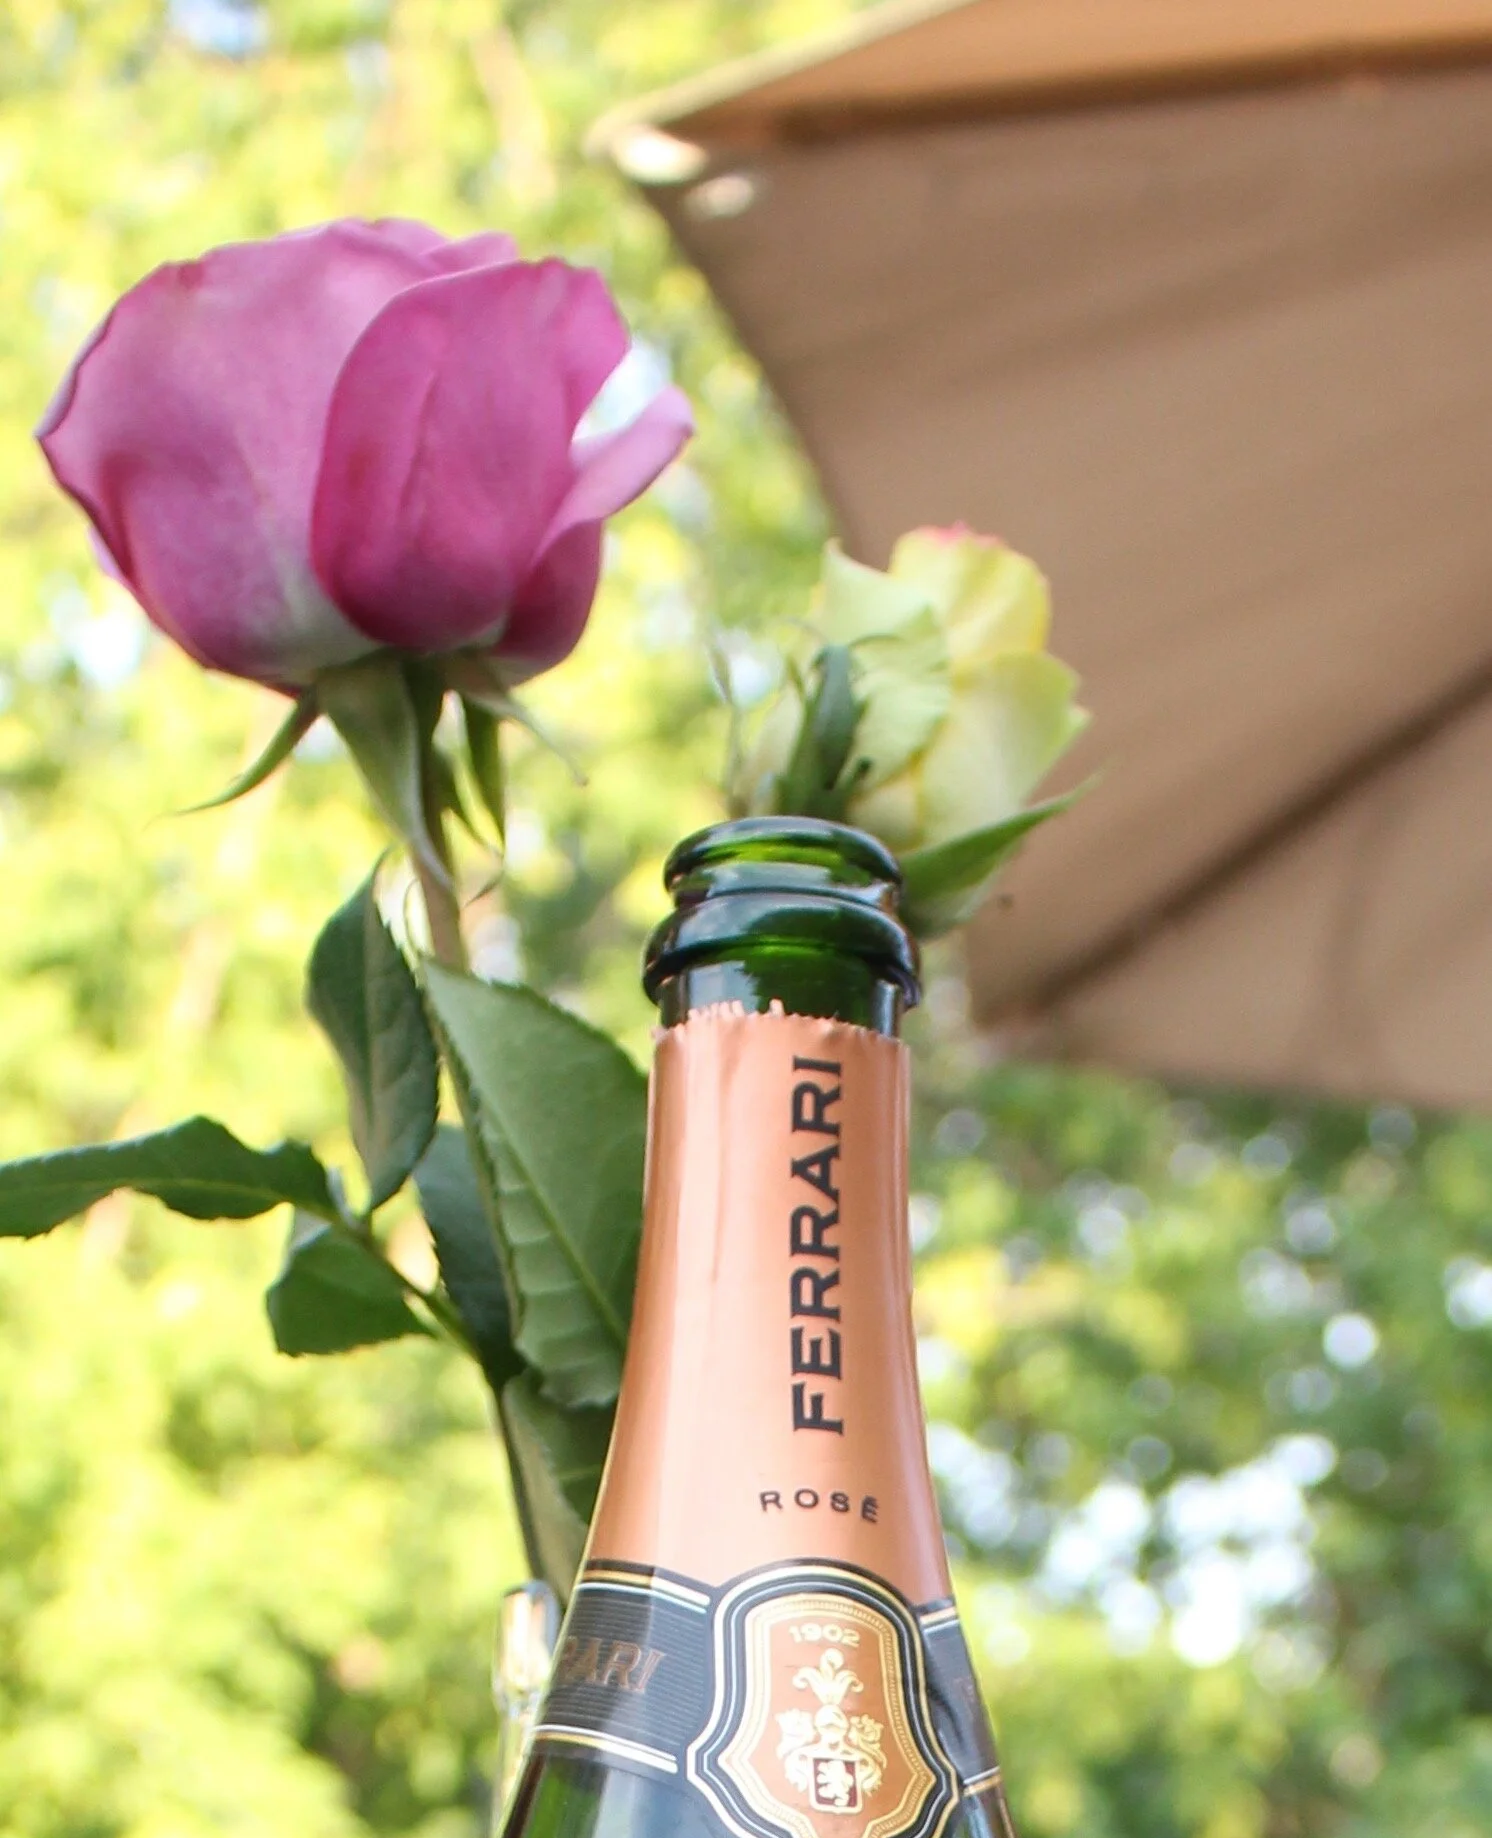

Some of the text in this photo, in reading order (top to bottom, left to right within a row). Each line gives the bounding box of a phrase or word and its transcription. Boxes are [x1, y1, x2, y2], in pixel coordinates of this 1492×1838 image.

[789, 1055, 844, 1436] FERRARI
[759, 1488, 879, 1523] ROSÉ
[789, 1623, 862, 1646] 1902
